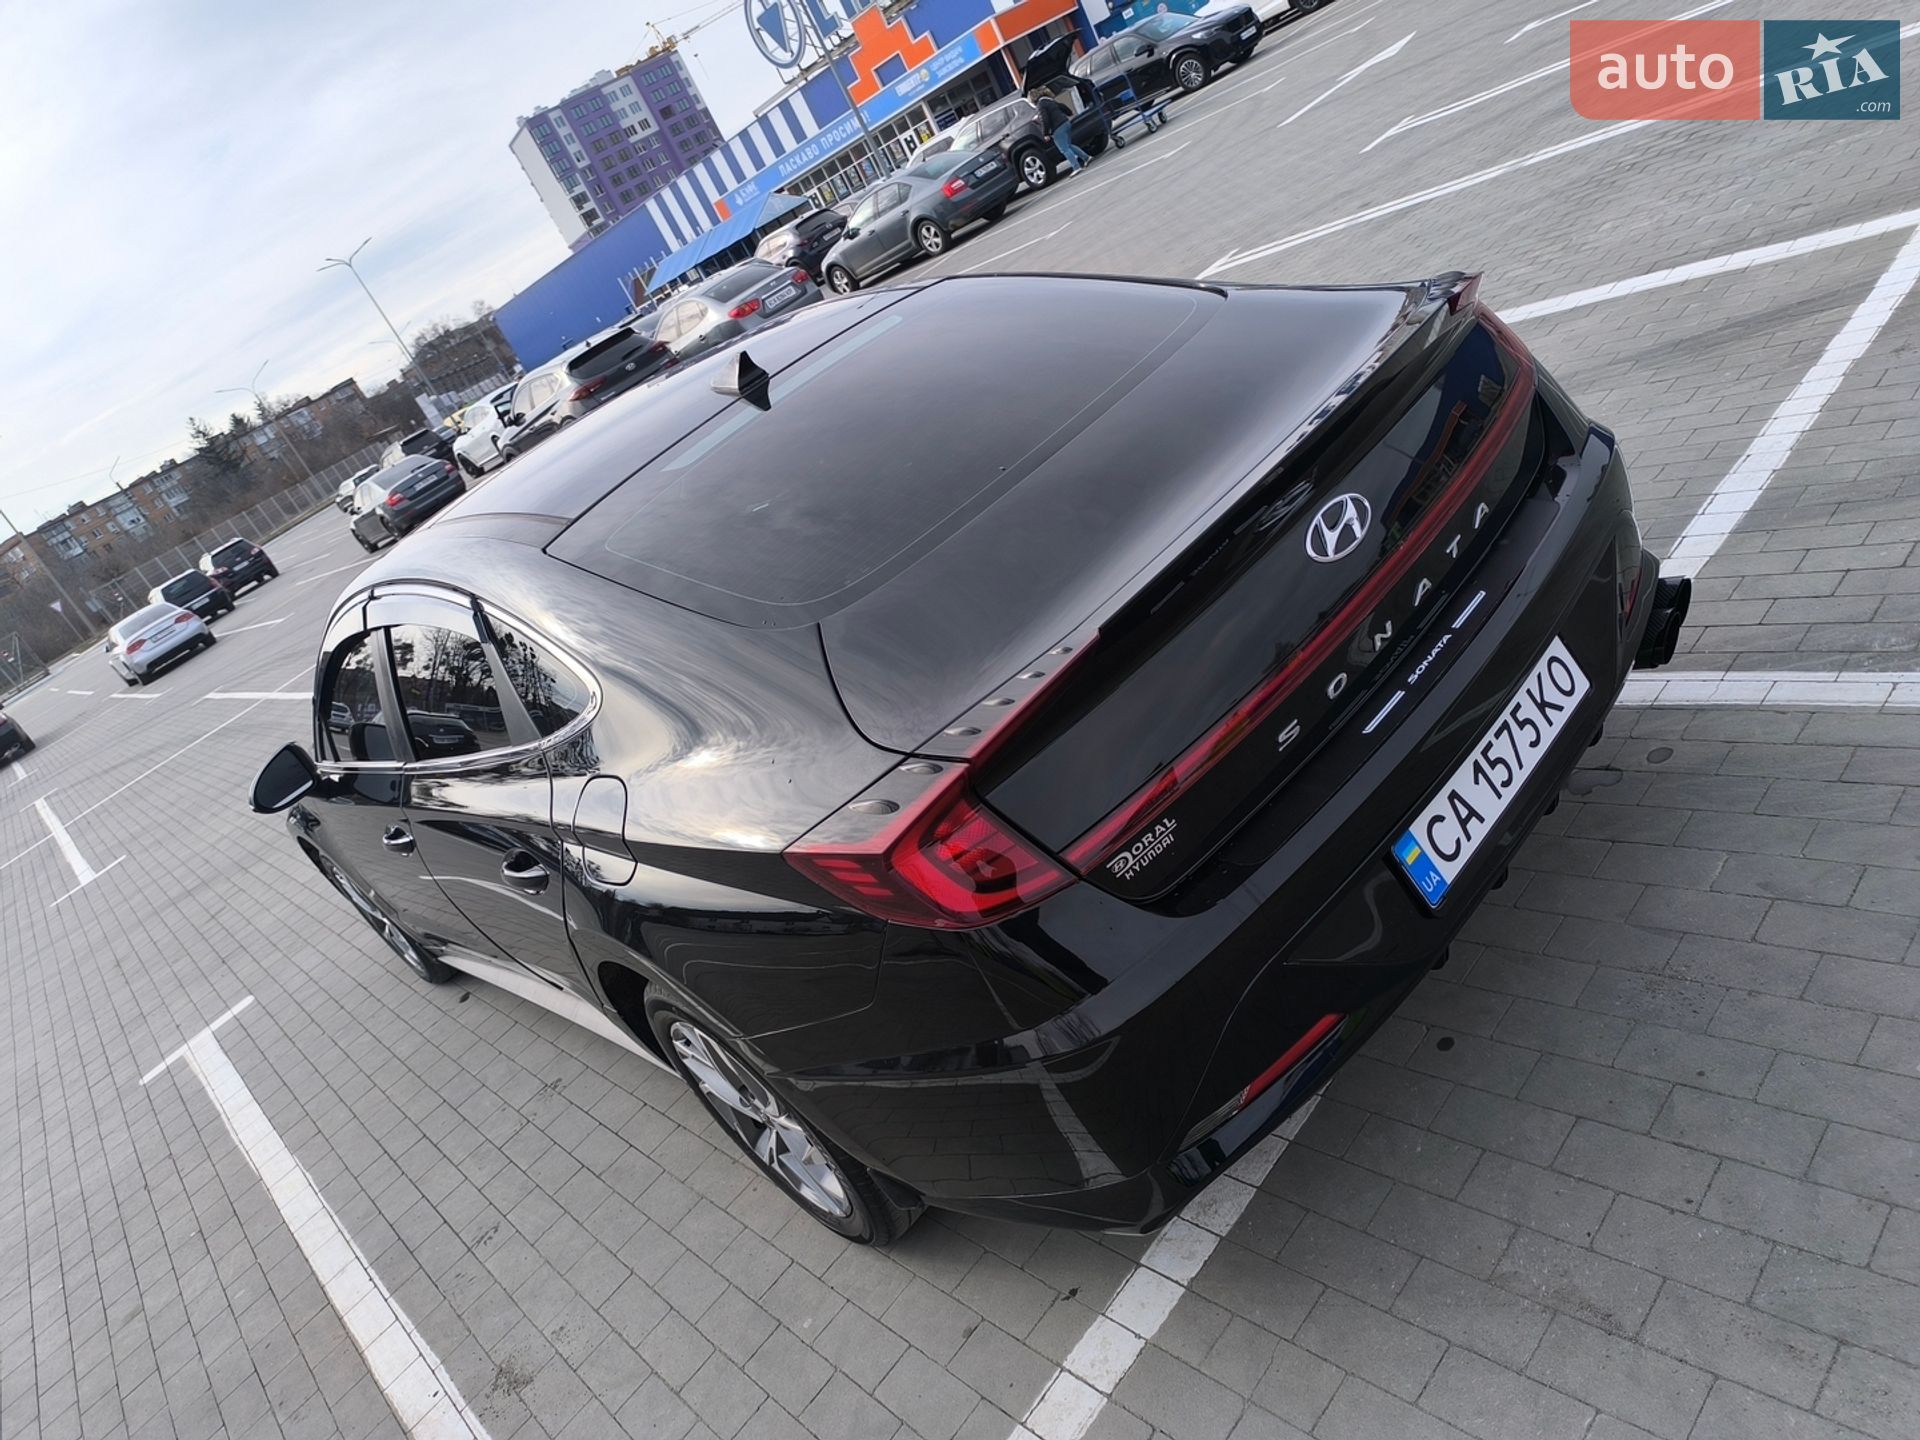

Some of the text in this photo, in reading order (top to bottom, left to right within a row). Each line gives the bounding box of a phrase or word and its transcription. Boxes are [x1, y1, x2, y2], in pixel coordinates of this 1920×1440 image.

[778, 143, 820, 177] ЛАСКАВО
[1277, 501, 1489, 752] SONATA
[1407, 634, 1453, 685] SONATA
[1106, 818, 1177, 878] DORAL
[1124, 833, 1175, 880] HYUNDAI
[1422, 870, 1442, 893] UA
